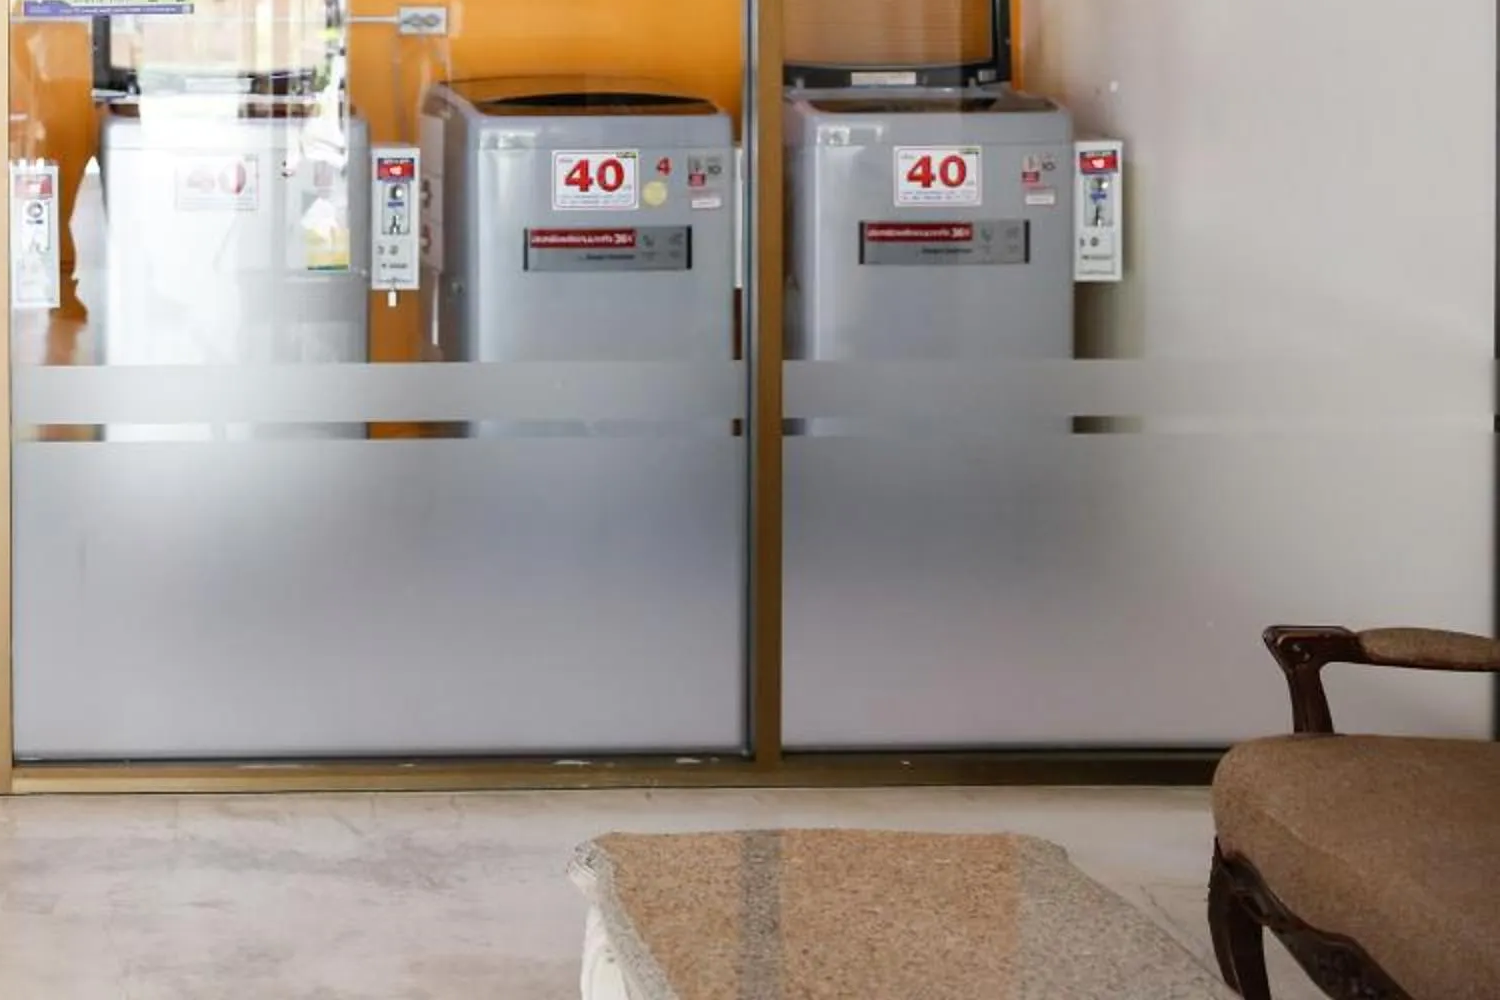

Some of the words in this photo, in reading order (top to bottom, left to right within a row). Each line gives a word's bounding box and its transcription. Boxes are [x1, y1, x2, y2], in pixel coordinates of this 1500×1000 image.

[564, 158, 625, 193] 40
[656, 157, 672, 176] 4
[907, 154, 967, 189] 40
